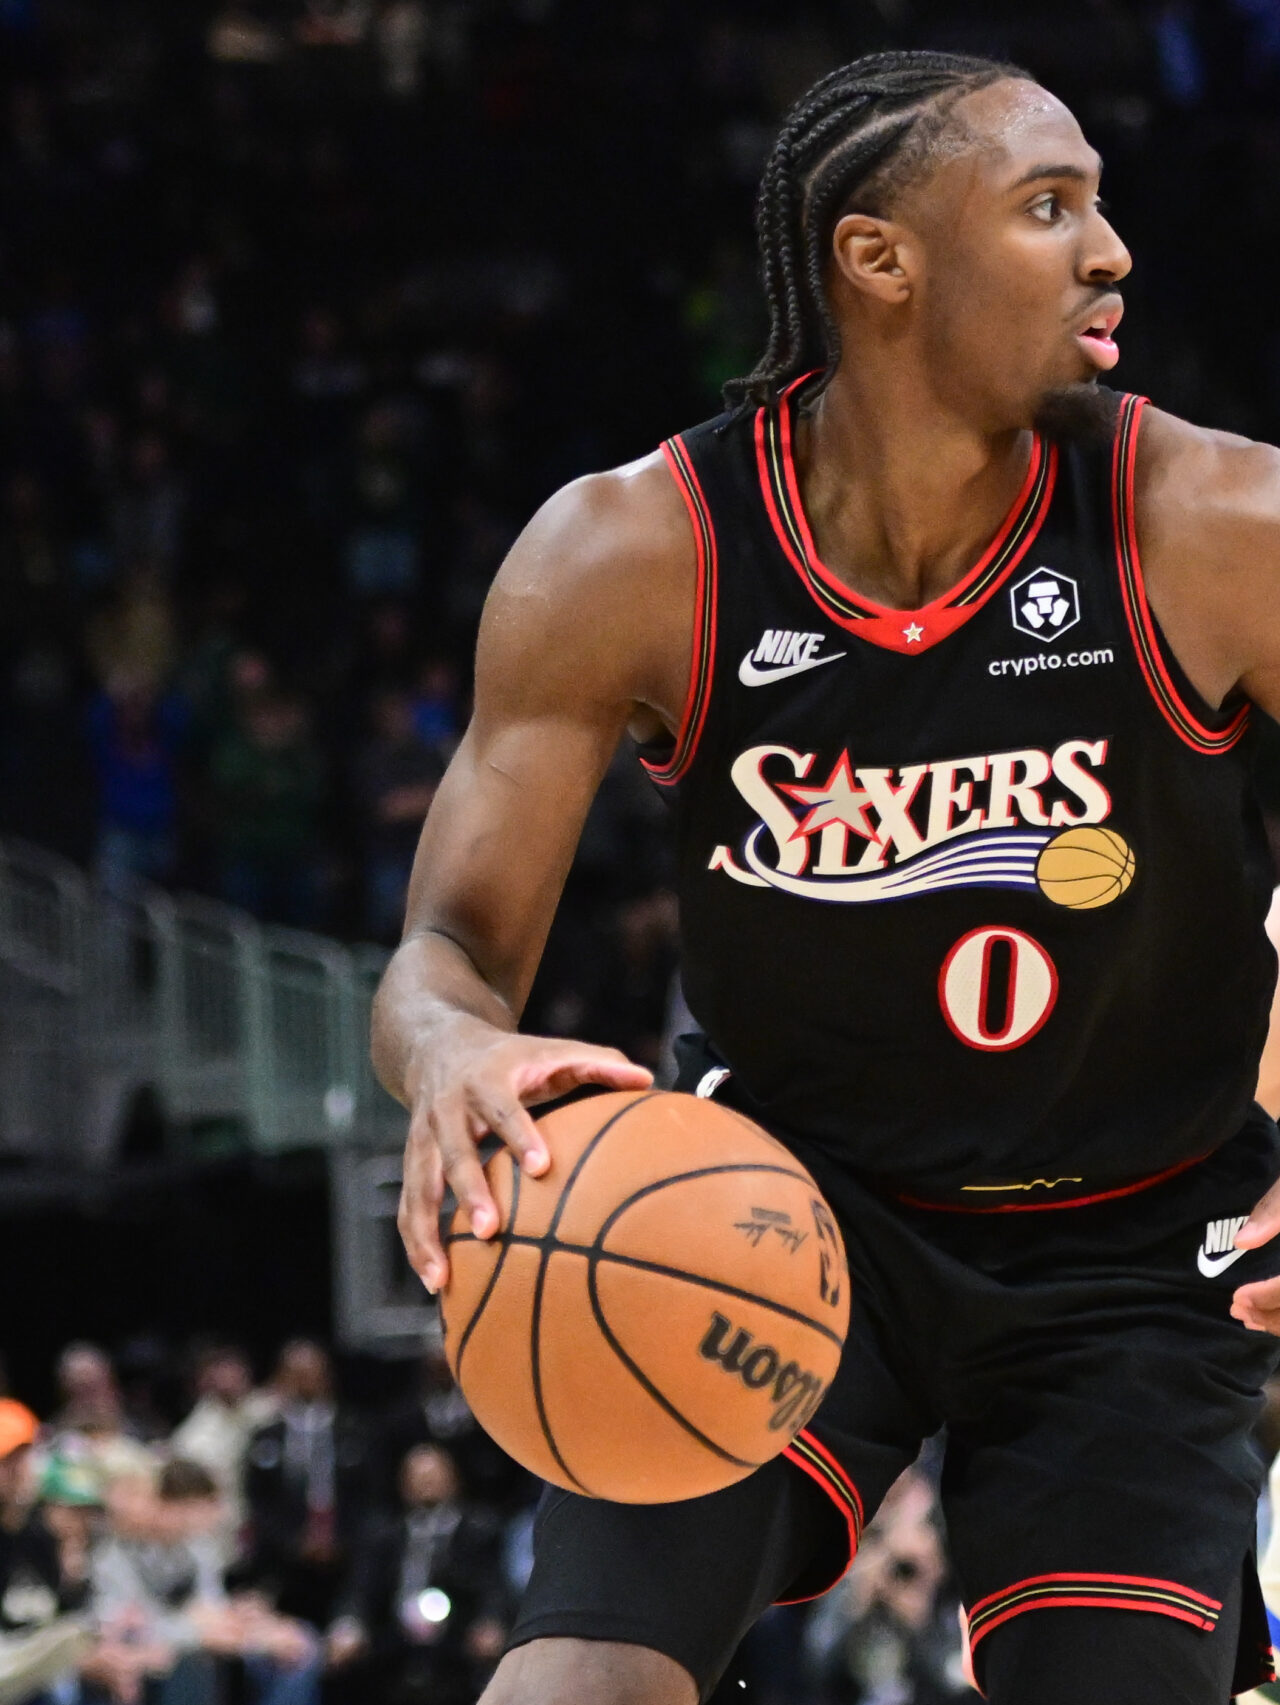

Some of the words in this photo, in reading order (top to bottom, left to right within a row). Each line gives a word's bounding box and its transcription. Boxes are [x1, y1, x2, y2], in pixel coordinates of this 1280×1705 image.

[752, 629, 826, 666] NIKE
[988, 648, 1114, 677] crypto.com
[937, 925, 1059, 1052] 0
[1205, 1215, 1251, 1255] NIK
